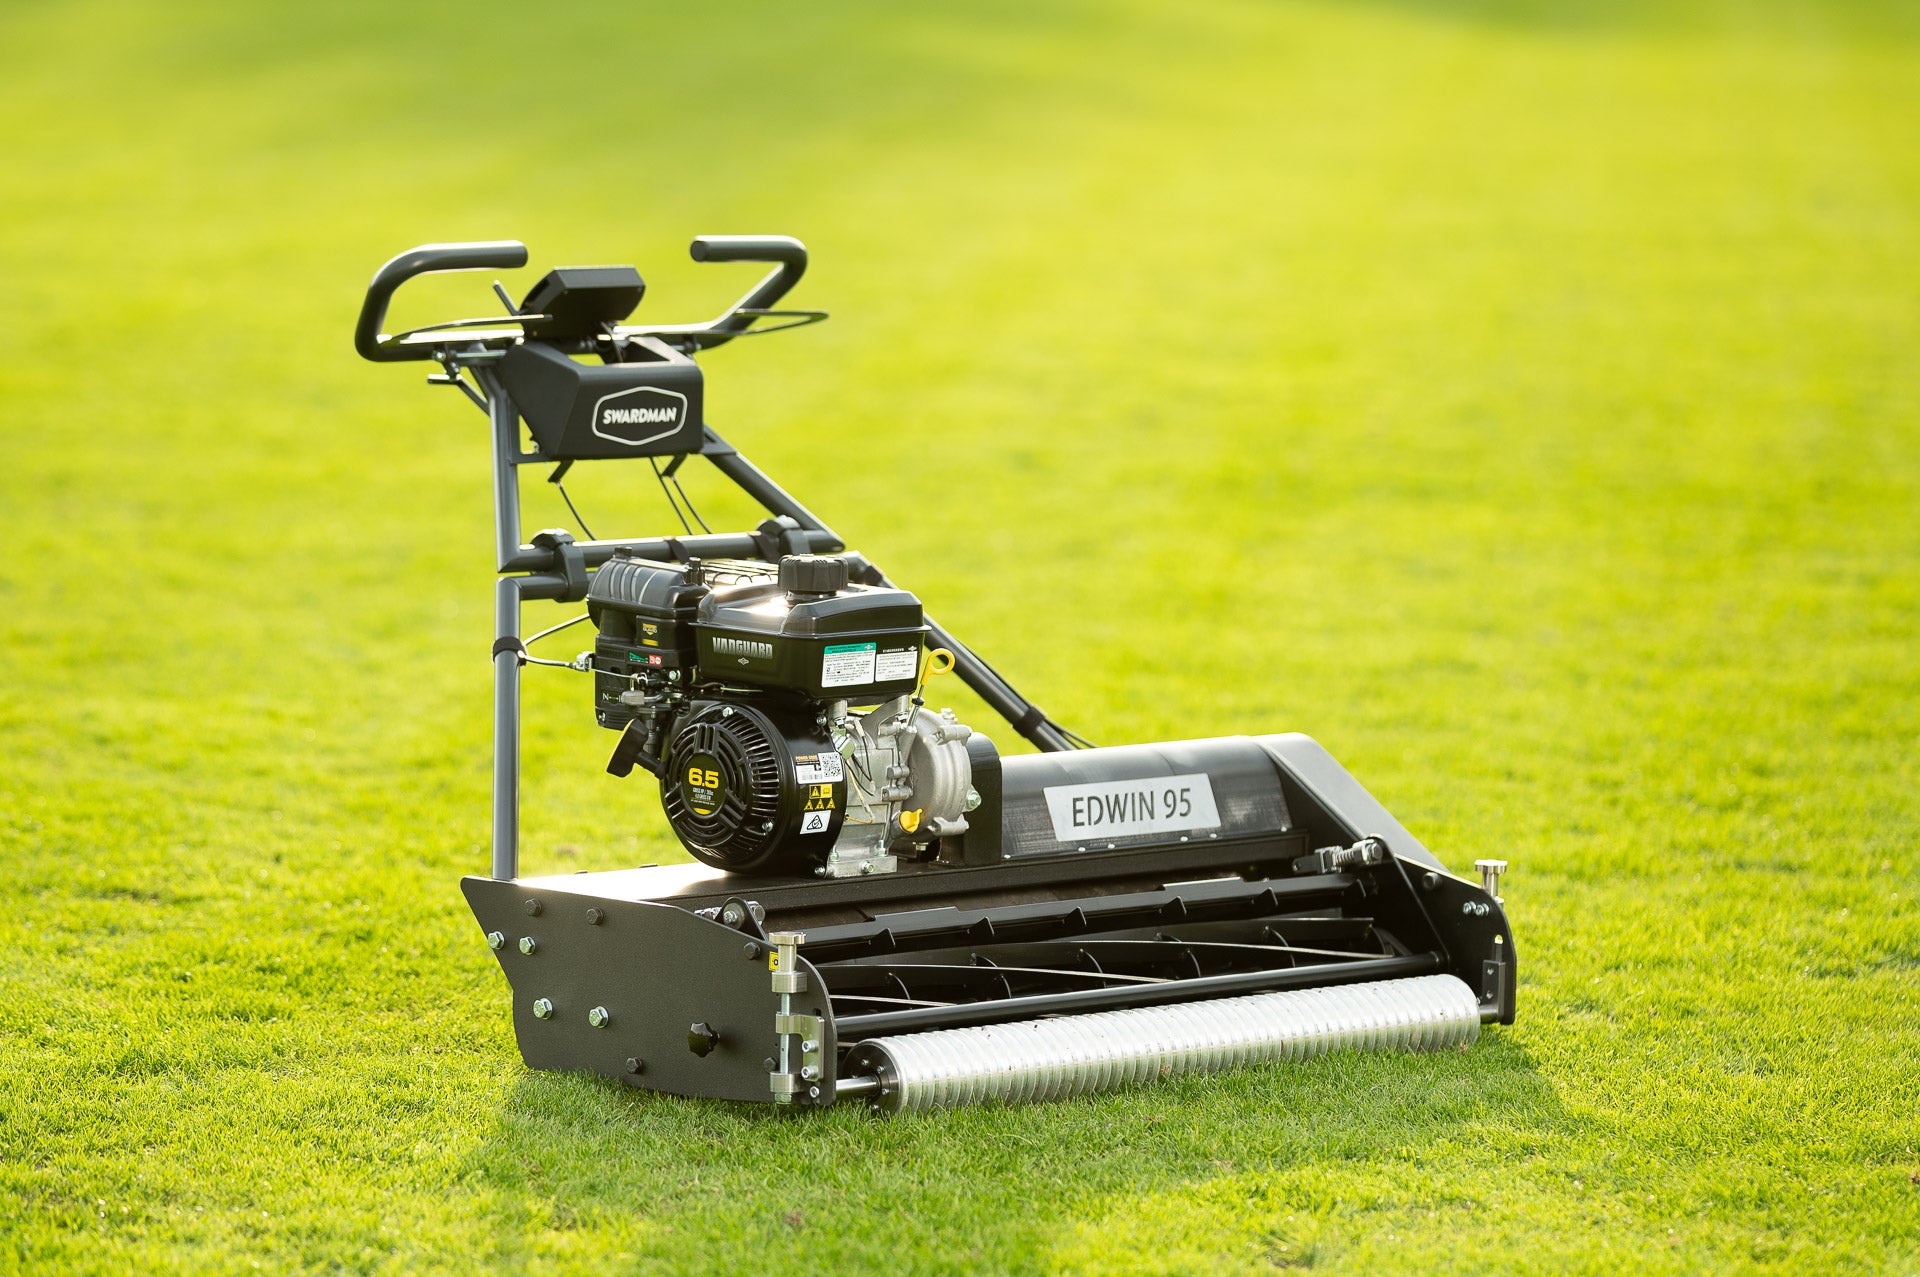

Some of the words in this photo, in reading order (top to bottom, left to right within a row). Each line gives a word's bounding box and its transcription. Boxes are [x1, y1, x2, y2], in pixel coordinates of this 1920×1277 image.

[602, 407, 677, 425] SWARDMAN
[712, 637, 773, 660] VANGUARD
[688, 767, 719, 789] 6.5
[1072, 790, 1155, 827] EDWIN
[1163, 788, 1192, 819] 95
